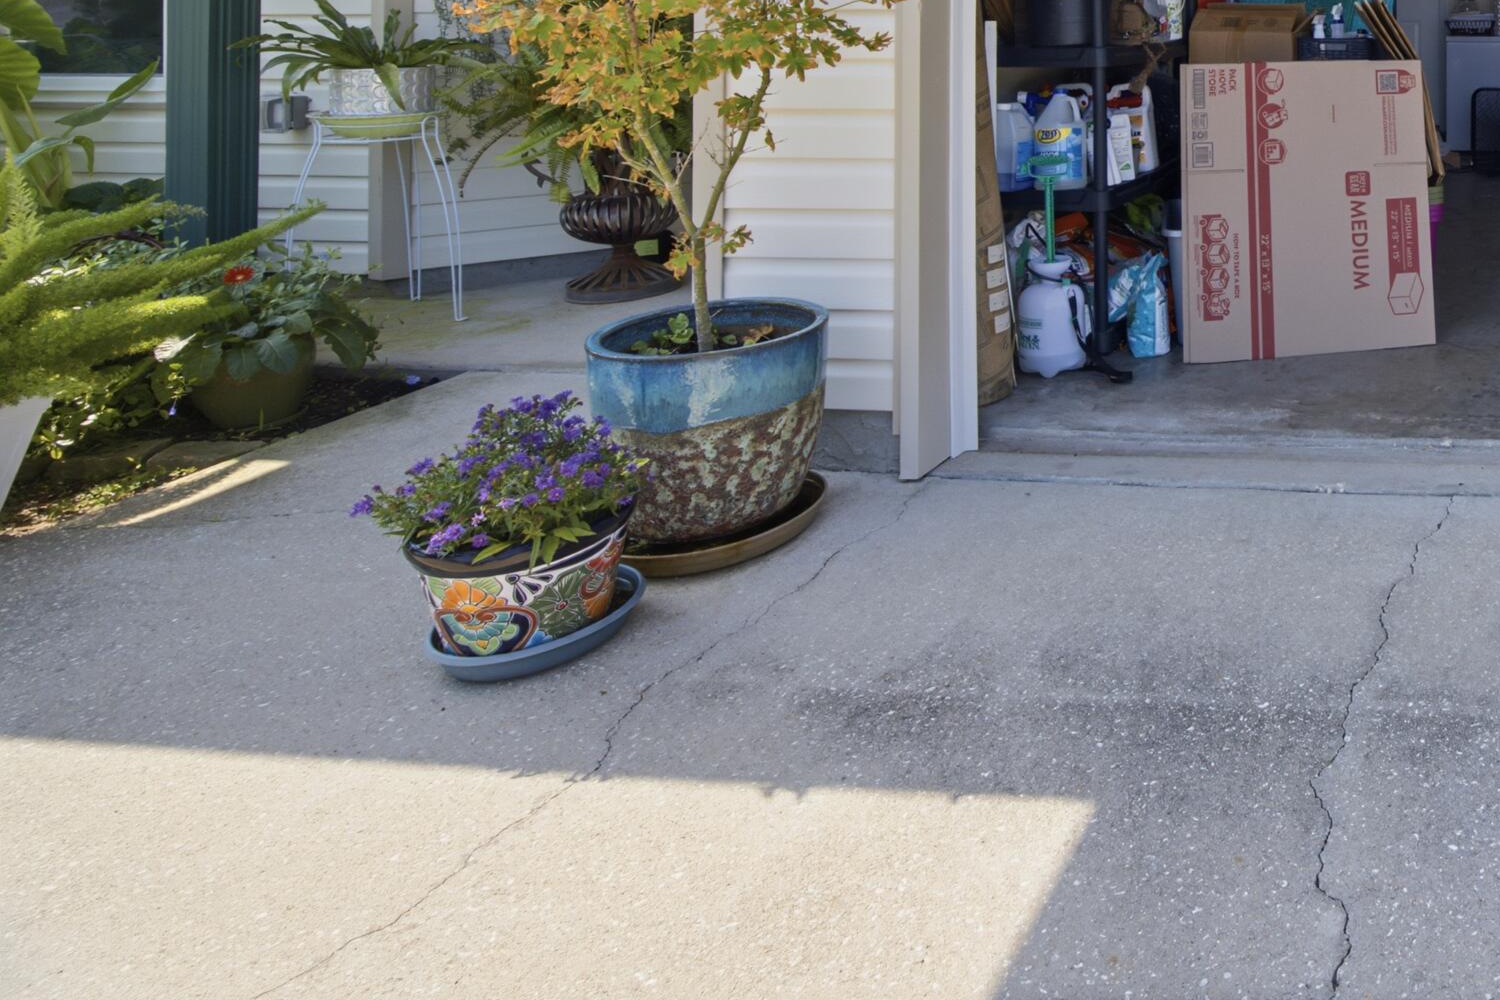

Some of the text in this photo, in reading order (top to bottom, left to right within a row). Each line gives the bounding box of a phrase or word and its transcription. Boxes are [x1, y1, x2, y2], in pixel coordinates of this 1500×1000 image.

[1208, 68, 1217, 97] STORE
[1218, 69, 1227, 95] MOVE
[1228, 68, 1237, 91] PACK
[1404, 204, 1412, 240] MEDIUM
[1350, 200, 1371, 290] MEDIUM
